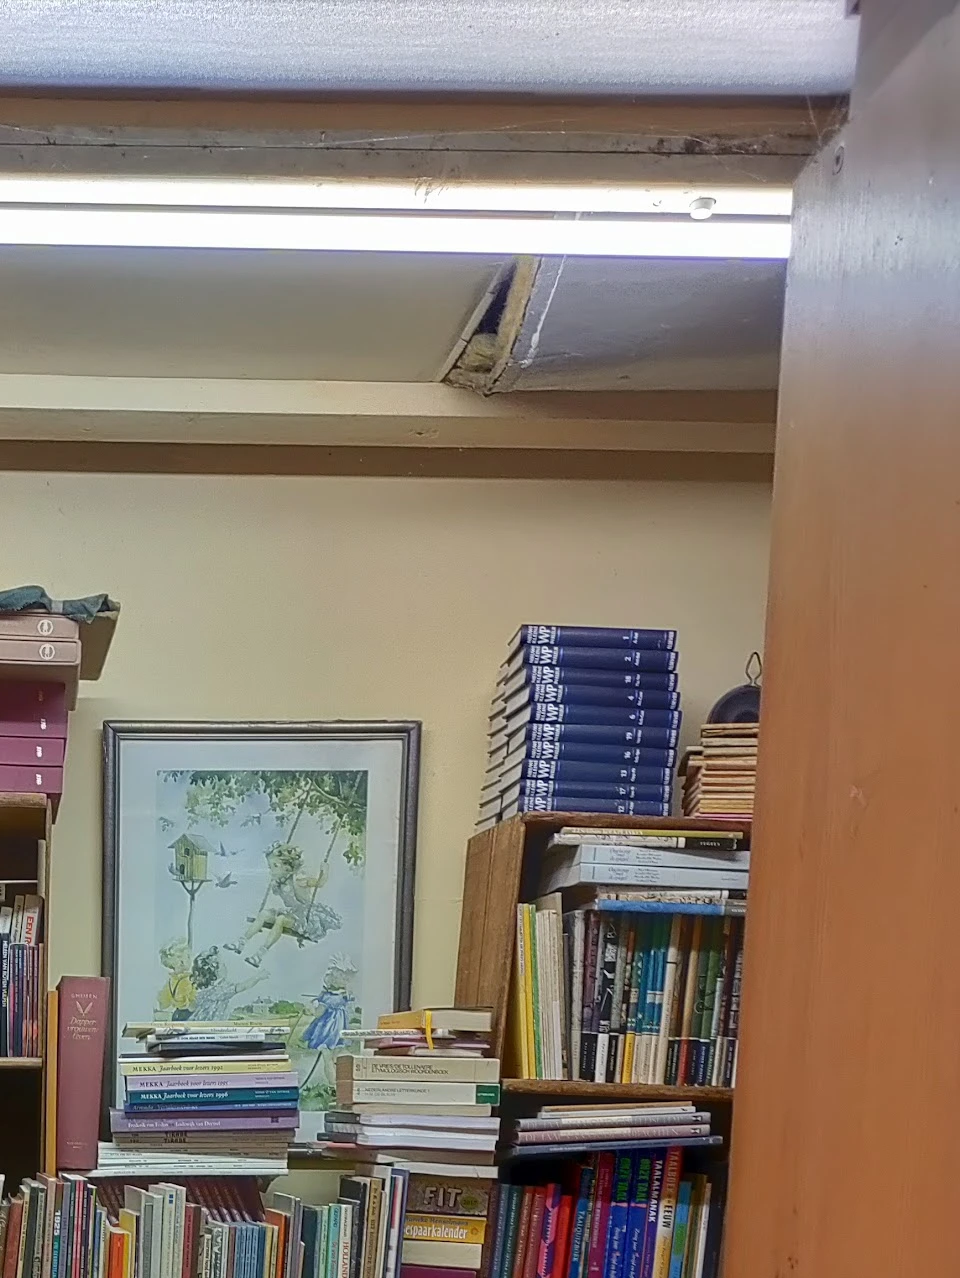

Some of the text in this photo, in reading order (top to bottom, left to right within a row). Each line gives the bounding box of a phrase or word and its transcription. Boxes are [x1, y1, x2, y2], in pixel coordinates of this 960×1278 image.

[159, 1065, 182, 1073] Jaarboek
[163, 1092, 186, 1100] Jaarboek
[423, 1186, 463, 1207] FIT
[648, 1159, 663, 1223] TAALALMANAK
